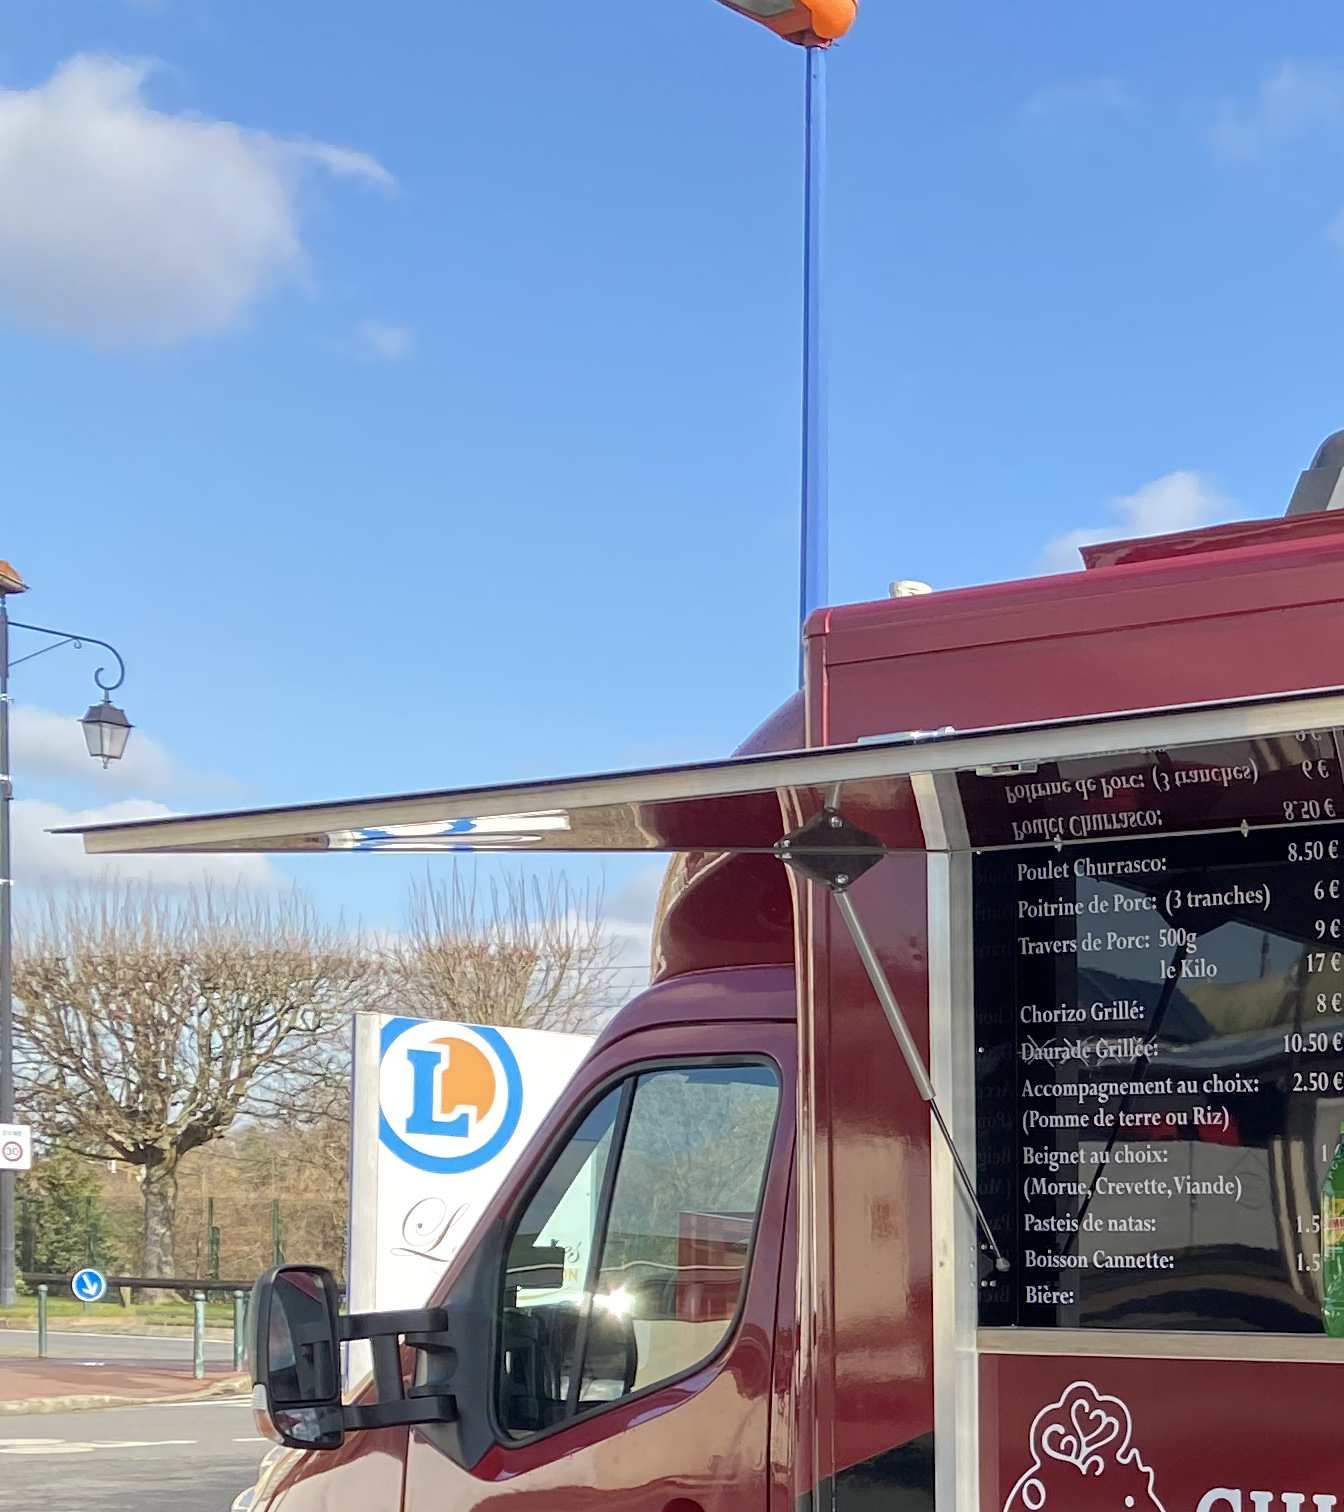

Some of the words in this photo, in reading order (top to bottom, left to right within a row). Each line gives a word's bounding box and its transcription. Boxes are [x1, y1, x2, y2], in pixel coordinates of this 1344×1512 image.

[1017, 862, 1069, 881] Poulet
[1074, 857, 1166, 878] Churrasco:
[1288, 841, 1324, 862] 8.50
[1328, 839, 1339, 859] €
[1018, 896, 1085, 918] Poitrine
[1088, 894, 1109, 913] de
[1114, 894, 1157, 913] Porc:
[1166, 889, 1181, 916] (3
[1186, 884, 1271, 911] tranches)
[1314, 882, 1324, 899] 6
[1329, 879, 1340, 898] €
[1018, 935, 1077, 956] Travers
[1081, 932, 1101, 952] de
[1106, 934, 1149, 952] Porc:
[1158, 929, 1197, 953] 500g
[1315, 920, 1325, 939] 9
[1330, 918, 1341, 938] €
[1160, 959, 1177, 980] le
[1181, 959, 1217, 978] Kilo
[1306, 953, 1325, 973] 17
[1330, 952, 1341, 972] €
[1020, 1005, 1087, 1023] Chorizo
[1091, 1001, 1145, 1021] Grillé:
[1317, 994, 1326, 1012] 8
[1331, 992, 1342, 1011] €
[1021, 1042, 1091, 1060] Daurade
[1282, 1033, 1328, 1053] 10.50
[1332, 1032, 1343, 1052] €
[1022, 1079, 1172, 1104] Accompagnement
[1177, 1079, 1198, 1095] au
[1202, 1073, 1259, 1094] choix:
[1292, 1073, 1328, 1092] 2.50
[1333, 1071, 1344, 1091] €
[1023, 1110, 1090, 1135] (Pomme
[1093, 1108, 1115, 1127] de
[1119, 1112, 1161, 1127] terre
[1166, 1111, 1188, 1125] ou
[1193, 1106, 1229, 1132] Riz)
[6, 1147, 19, 1156] 30
[1023, 1147, 1084, 1171] Beignet
[1089, 1148, 1110, 1164] au
[1115, 1145, 1168, 1163] choix:
[1024, 1177, 1093, 1202] (Morue,
[1024, 1214, 1078, 1232] Pasteis
[1083, 1213, 1103, 1231] de
[1107, 1217, 1156, 1232] natas:
[1296, 1215, 1320, 1233] 1.5
[1025, 1250, 1087, 1269] Boisson
[1092, 1250, 1174, 1269] Cannette:
[1296, 1253, 1320, 1271] 1.5
[1026, 1284, 1074, 1304] Bière:
